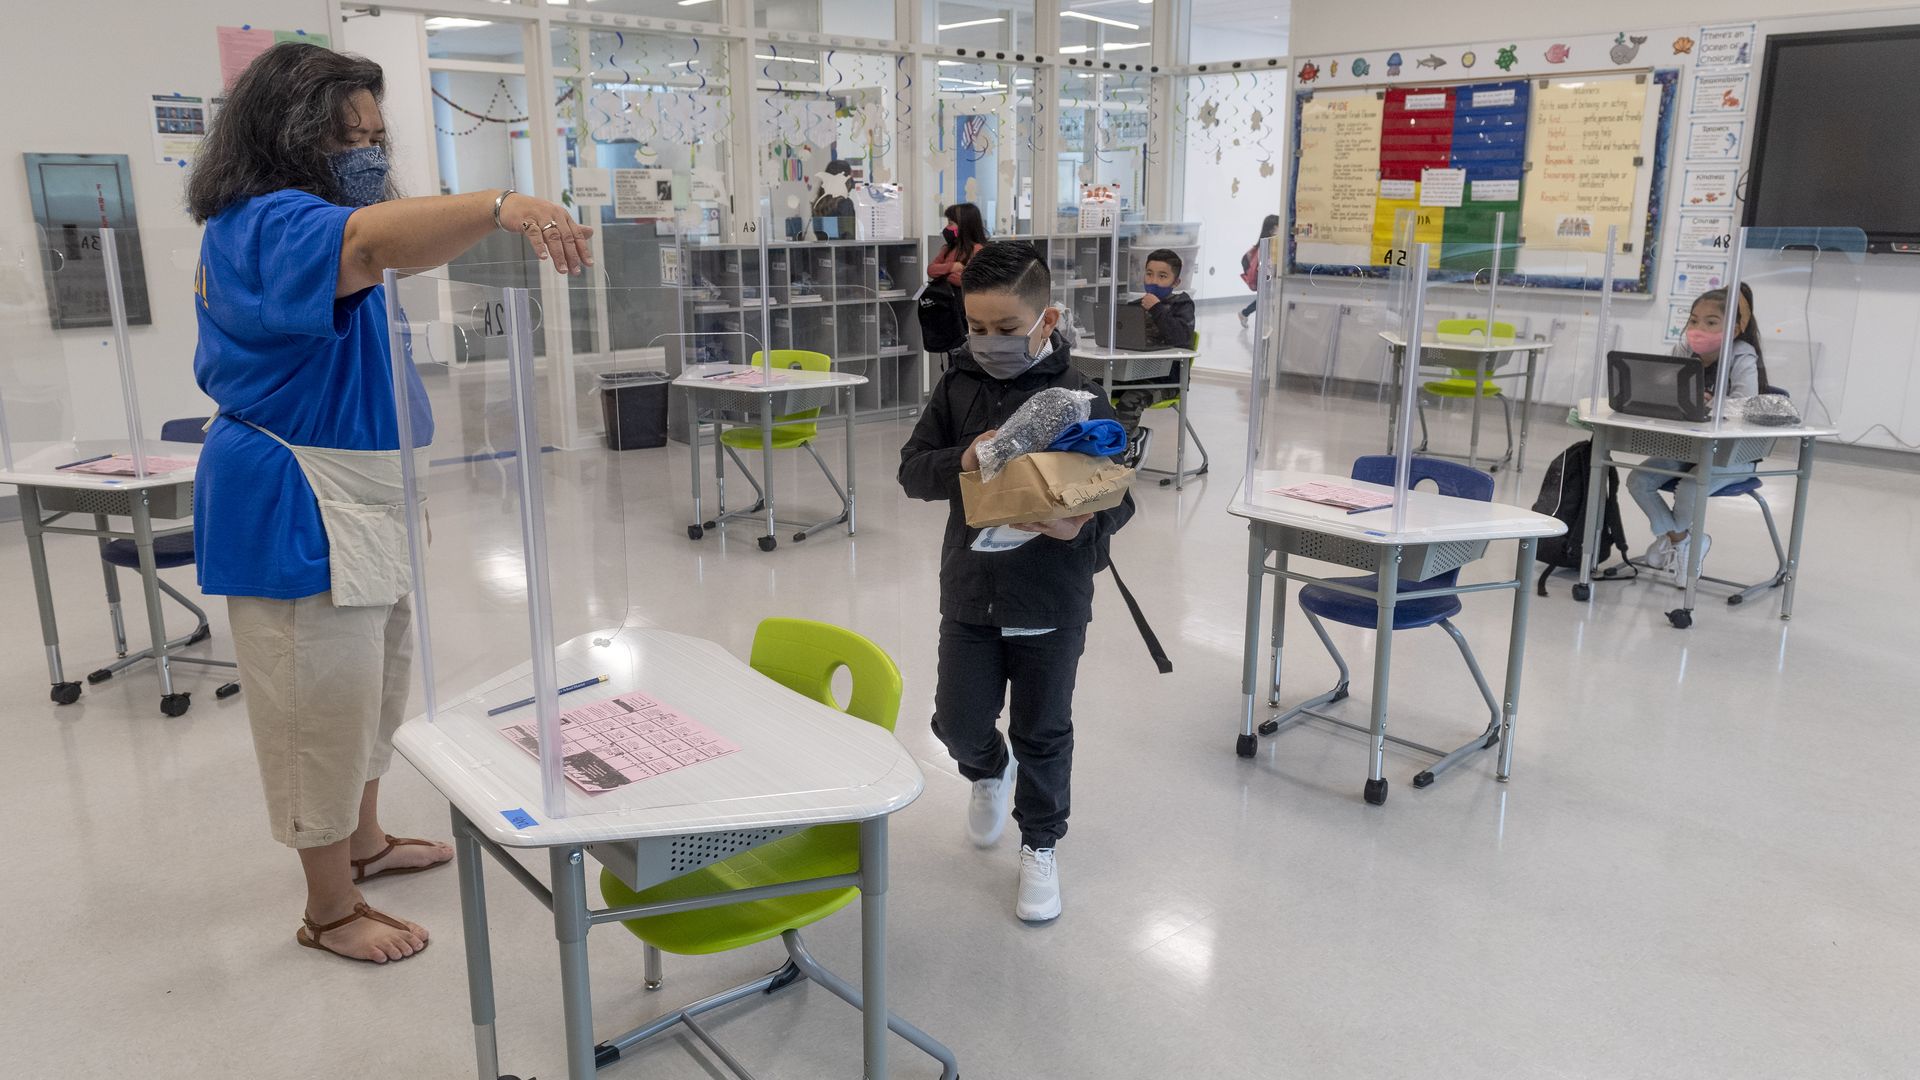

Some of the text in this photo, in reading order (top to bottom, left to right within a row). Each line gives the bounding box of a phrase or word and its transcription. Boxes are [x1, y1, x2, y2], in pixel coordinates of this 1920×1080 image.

[1703, 31, 1732, 40] There's
[1702, 44, 1728, 53] Ocean
[1328, 101, 1349, 112] PRIDE
[783, 158, 803, 181] KIND
[96, 183, 105, 212] FIRE
[1692, 217, 1720, 225] Courage
[1686, 263, 1715, 271] Patience
